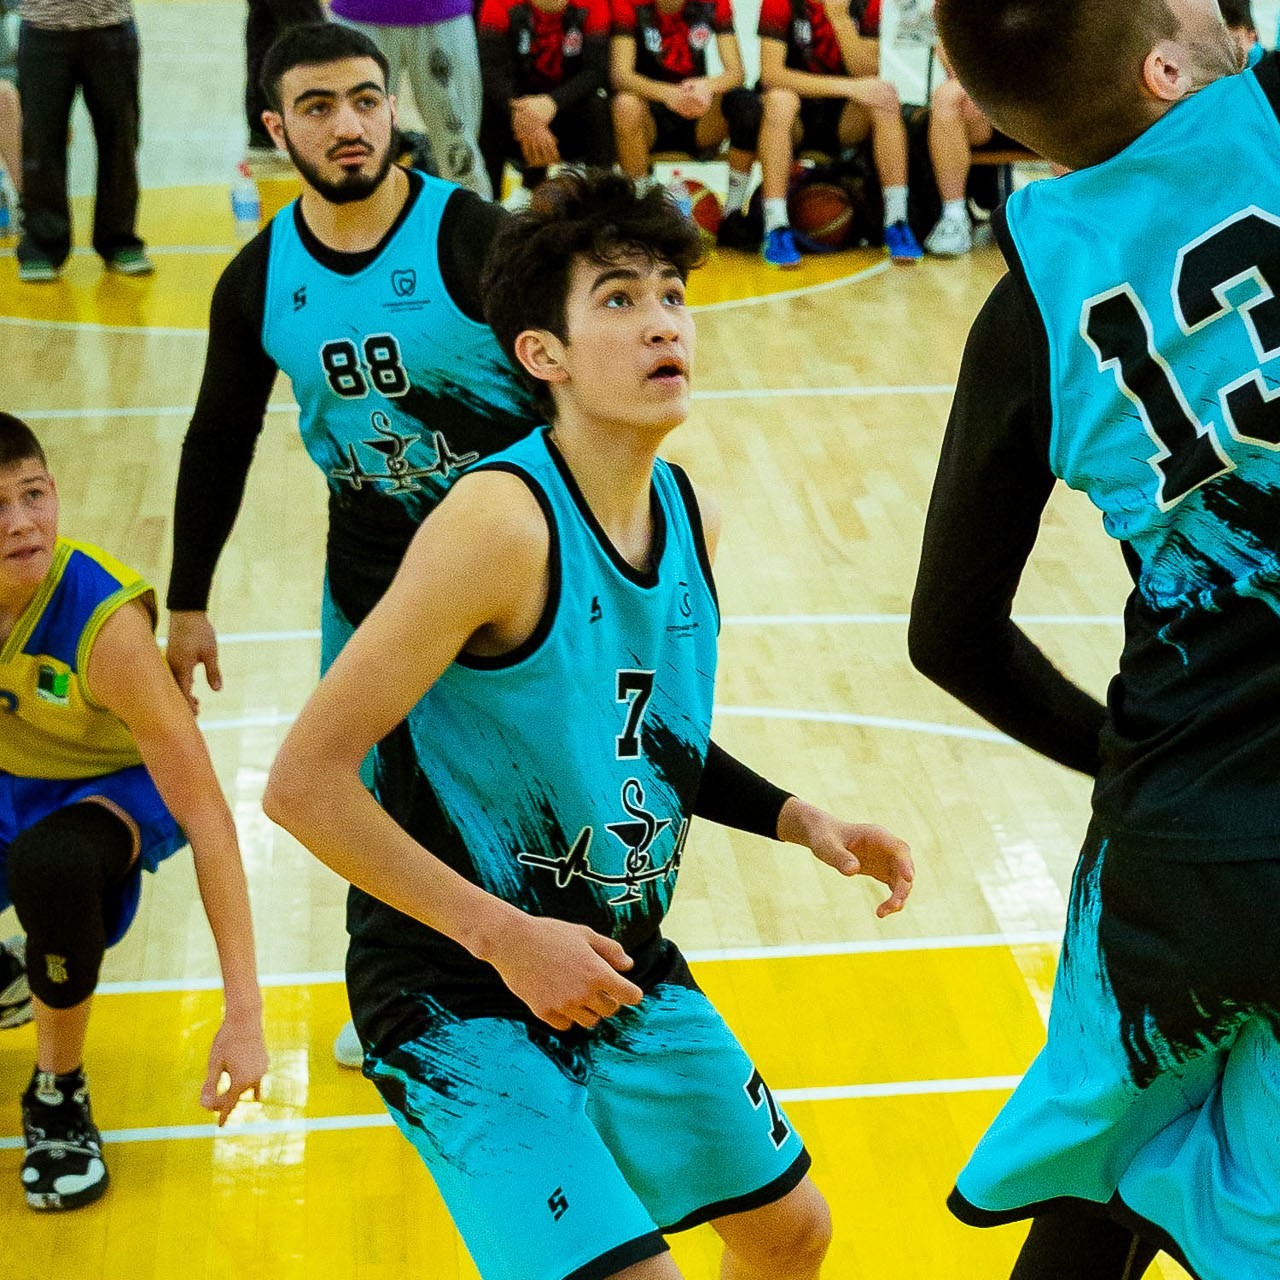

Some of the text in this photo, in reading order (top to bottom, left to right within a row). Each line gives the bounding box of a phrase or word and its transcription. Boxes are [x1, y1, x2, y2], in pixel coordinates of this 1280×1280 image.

[320, 331, 411, 400] 88
[616, 669, 656, 760] 7
[743, 1067, 790, 1151] 7
